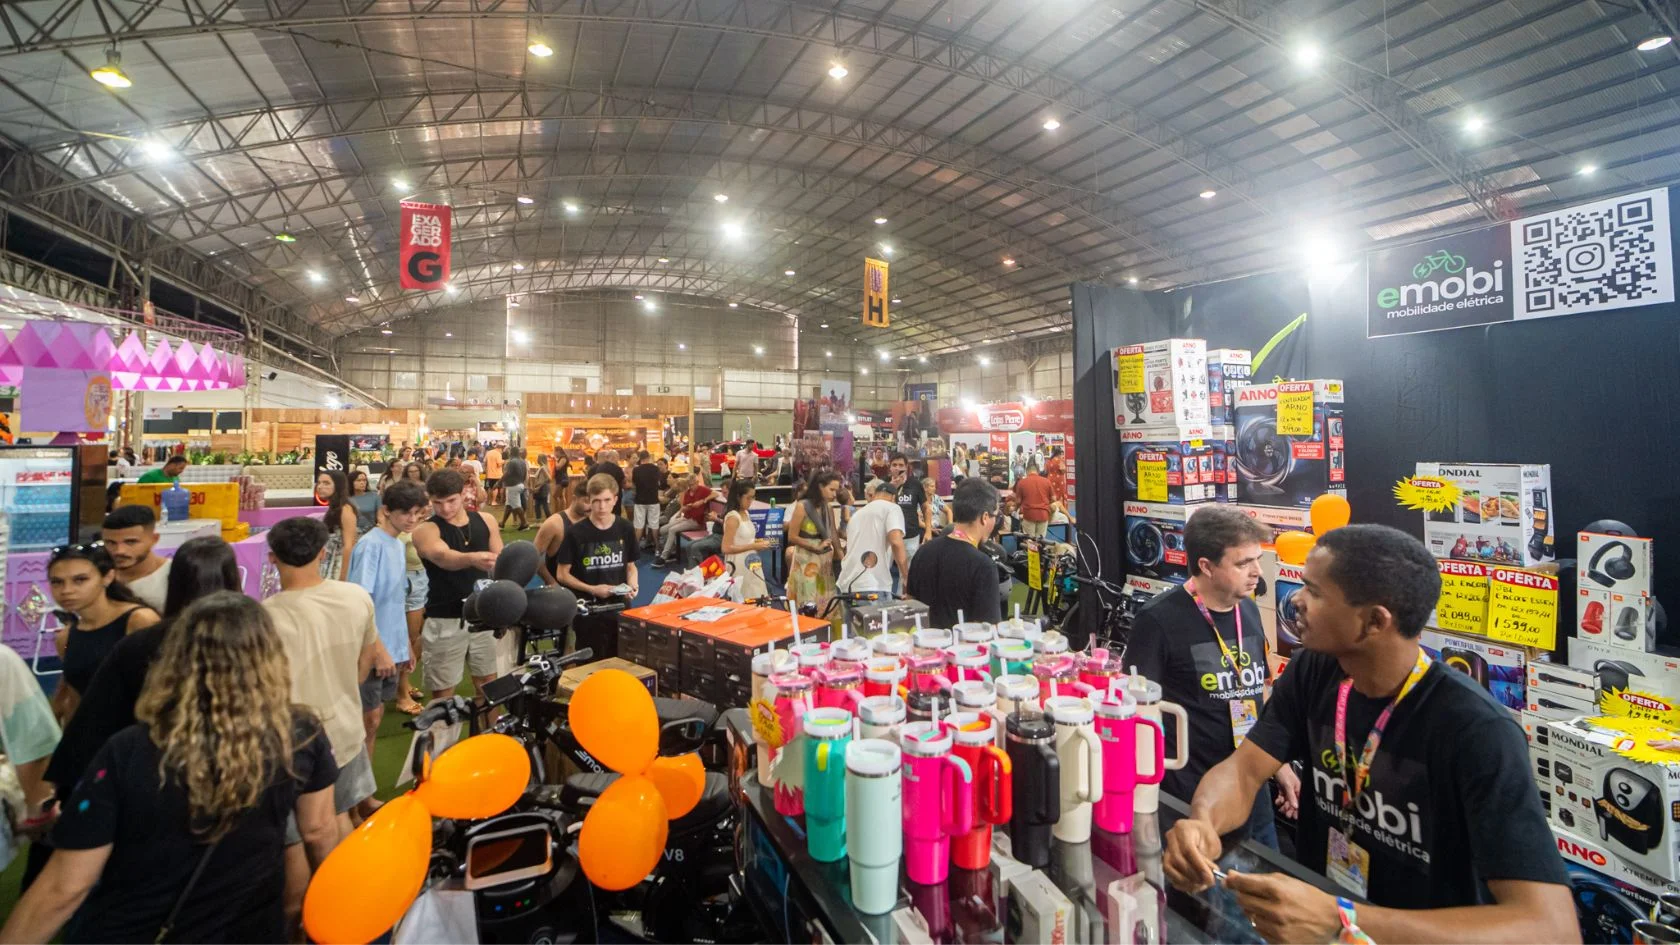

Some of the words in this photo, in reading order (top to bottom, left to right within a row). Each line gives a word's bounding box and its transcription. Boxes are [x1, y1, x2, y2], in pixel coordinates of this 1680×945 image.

[412, 213, 441, 226] EXA
[411, 225, 442, 237] GER
[410, 235, 442, 247] ADO
[408, 251, 443, 283] G
[1377, 260, 1503, 309] emobi
[868, 296, 883, 323] H
[1387, 302, 1454, 319] mobilidade
[1456, 295, 1504, 308] elétrica
[1119, 346, 1142, 355] OFERTA
[1279, 383, 1310, 392] OFERTA
[1239, 388, 1277, 401] ARNO
[1138, 453, 1165, 461] OFERTA
[1438, 469, 1482, 477] ONDIAL
[1411, 480, 1441, 488] OFERTA
[898, 494, 912, 502] obi
[1126, 505, 1148, 513] ARNO
[583, 551, 623, 566] emobi
[1280, 568, 1303, 579] ARN
[1438, 562, 1483, 575] OFERTA
[1129, 579, 1151, 589] ARNO
[1496, 570, 1552, 589] OFERTA
[1201, 661, 1265, 691] emob
[1622, 694, 1666, 711] OFERTA
[1551, 730, 1605, 758] MONDIAL
[1312, 767, 1422, 844] mobi
[1373, 829, 1431, 864] elétrica
[1557, 837, 1607, 867] RNO
[664, 848, 684, 862] V8
[1623, 865, 1657, 884] XTREME
